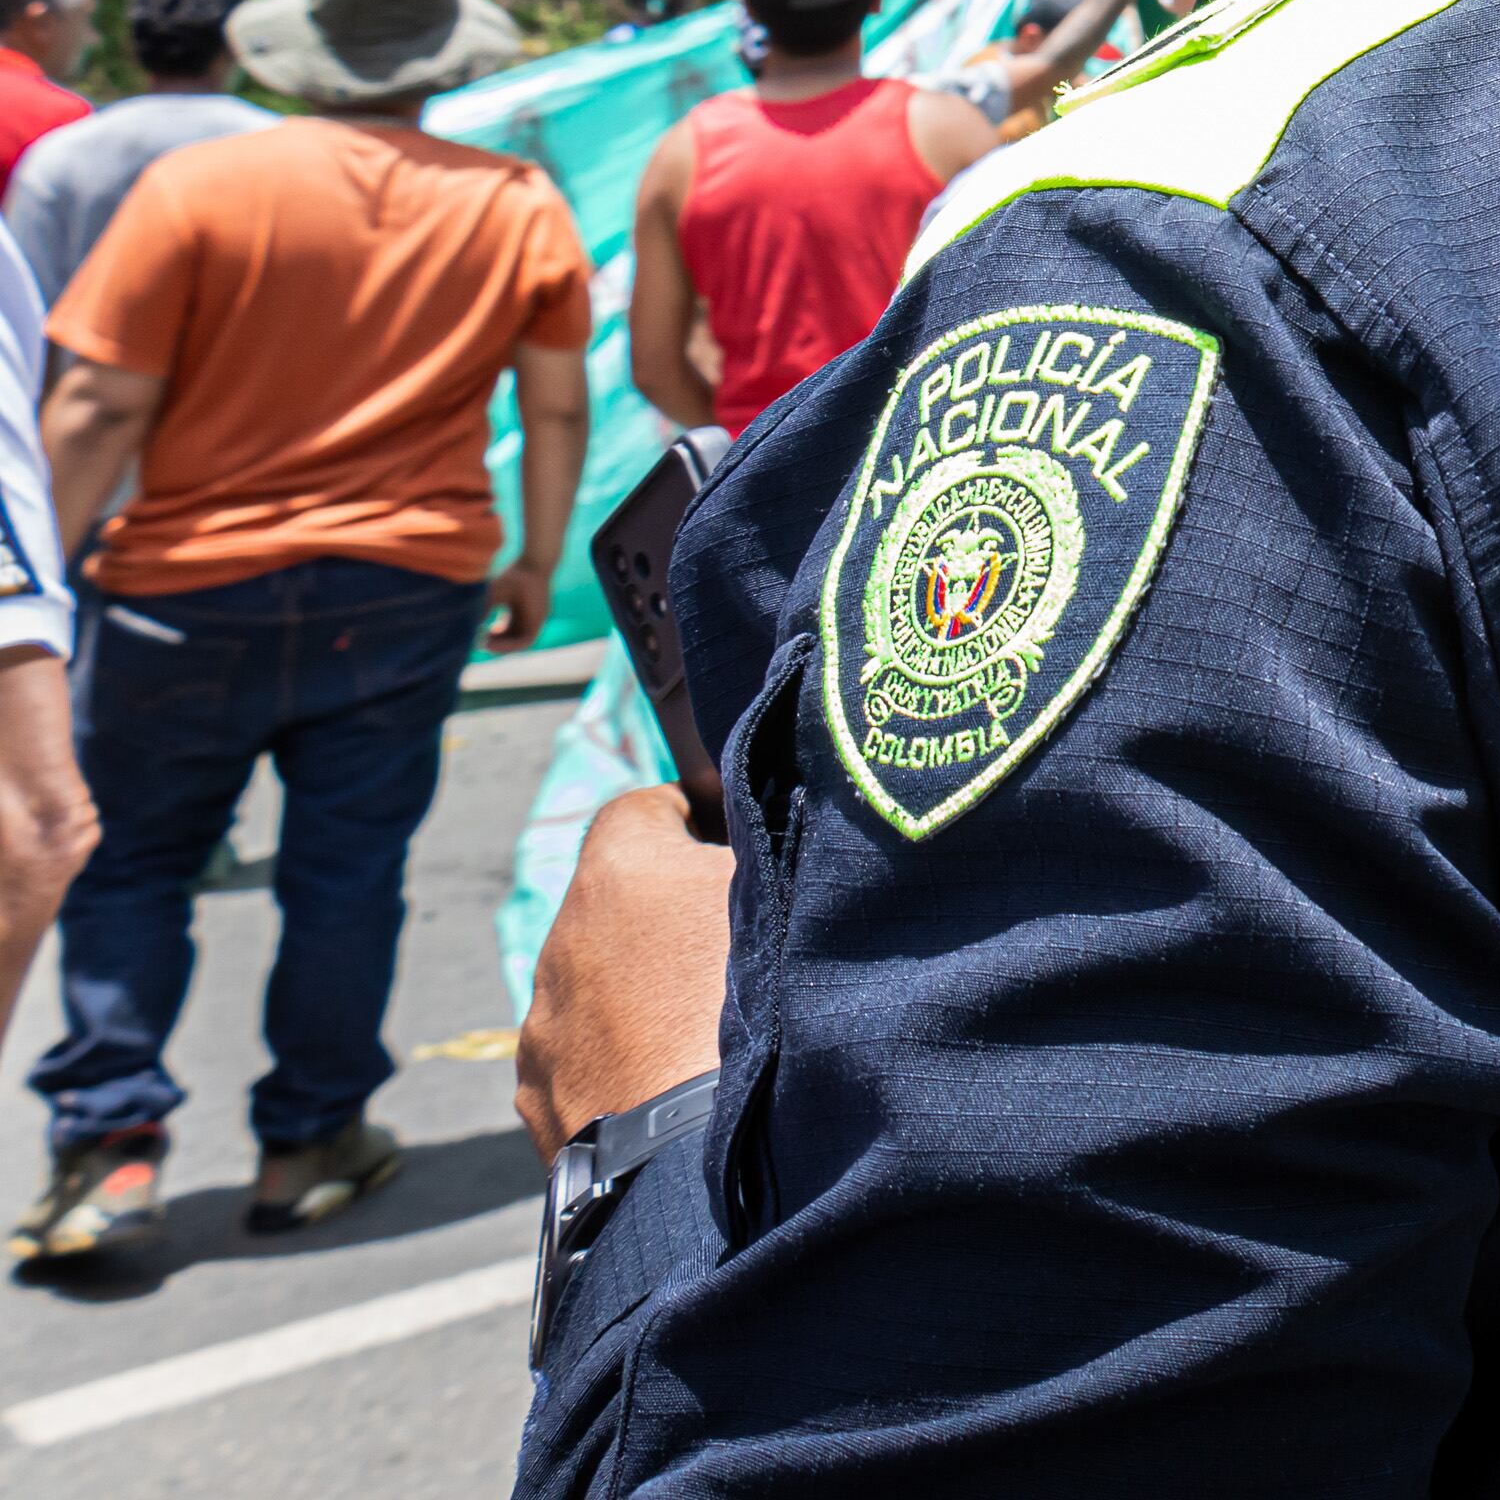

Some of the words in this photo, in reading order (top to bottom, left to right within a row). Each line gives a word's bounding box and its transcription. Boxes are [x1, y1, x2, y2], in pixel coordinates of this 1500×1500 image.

[918, 331, 1152, 423] POLICÍA
[868, 391, 1149, 518] NACIONAL
[864, 719, 1010, 770] COLOMBIA
